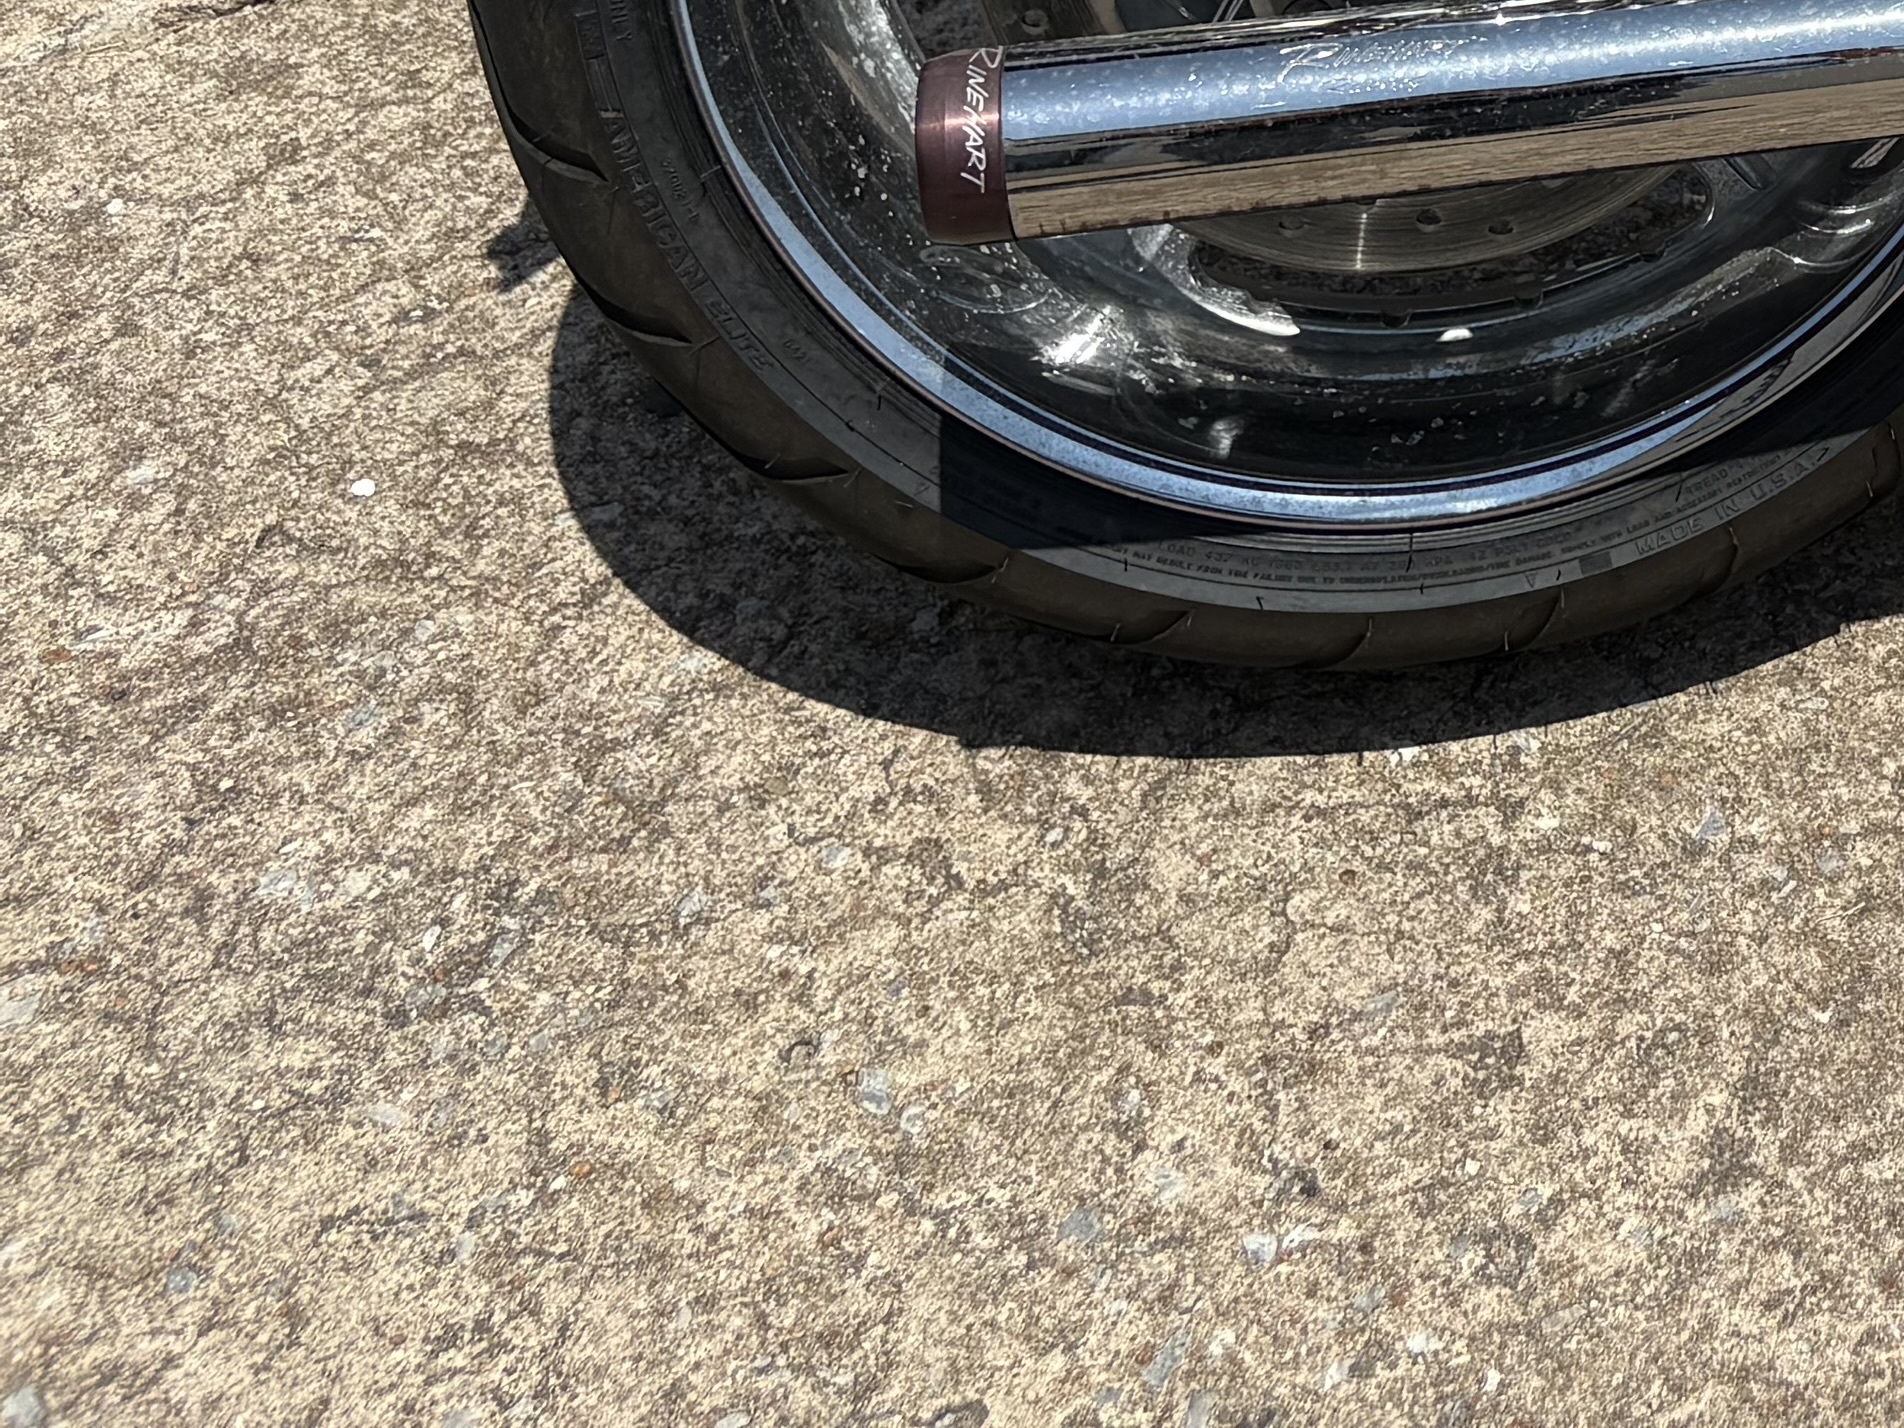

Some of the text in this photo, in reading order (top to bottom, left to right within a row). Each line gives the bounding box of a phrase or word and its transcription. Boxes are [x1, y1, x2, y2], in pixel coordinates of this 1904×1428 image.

[960, 45, 1004, 194] RINEHART
[598, 102, 709, 305] AMERICAN
[1633, 514, 1706, 556] MADE
[1711, 495, 1743, 522] IN
